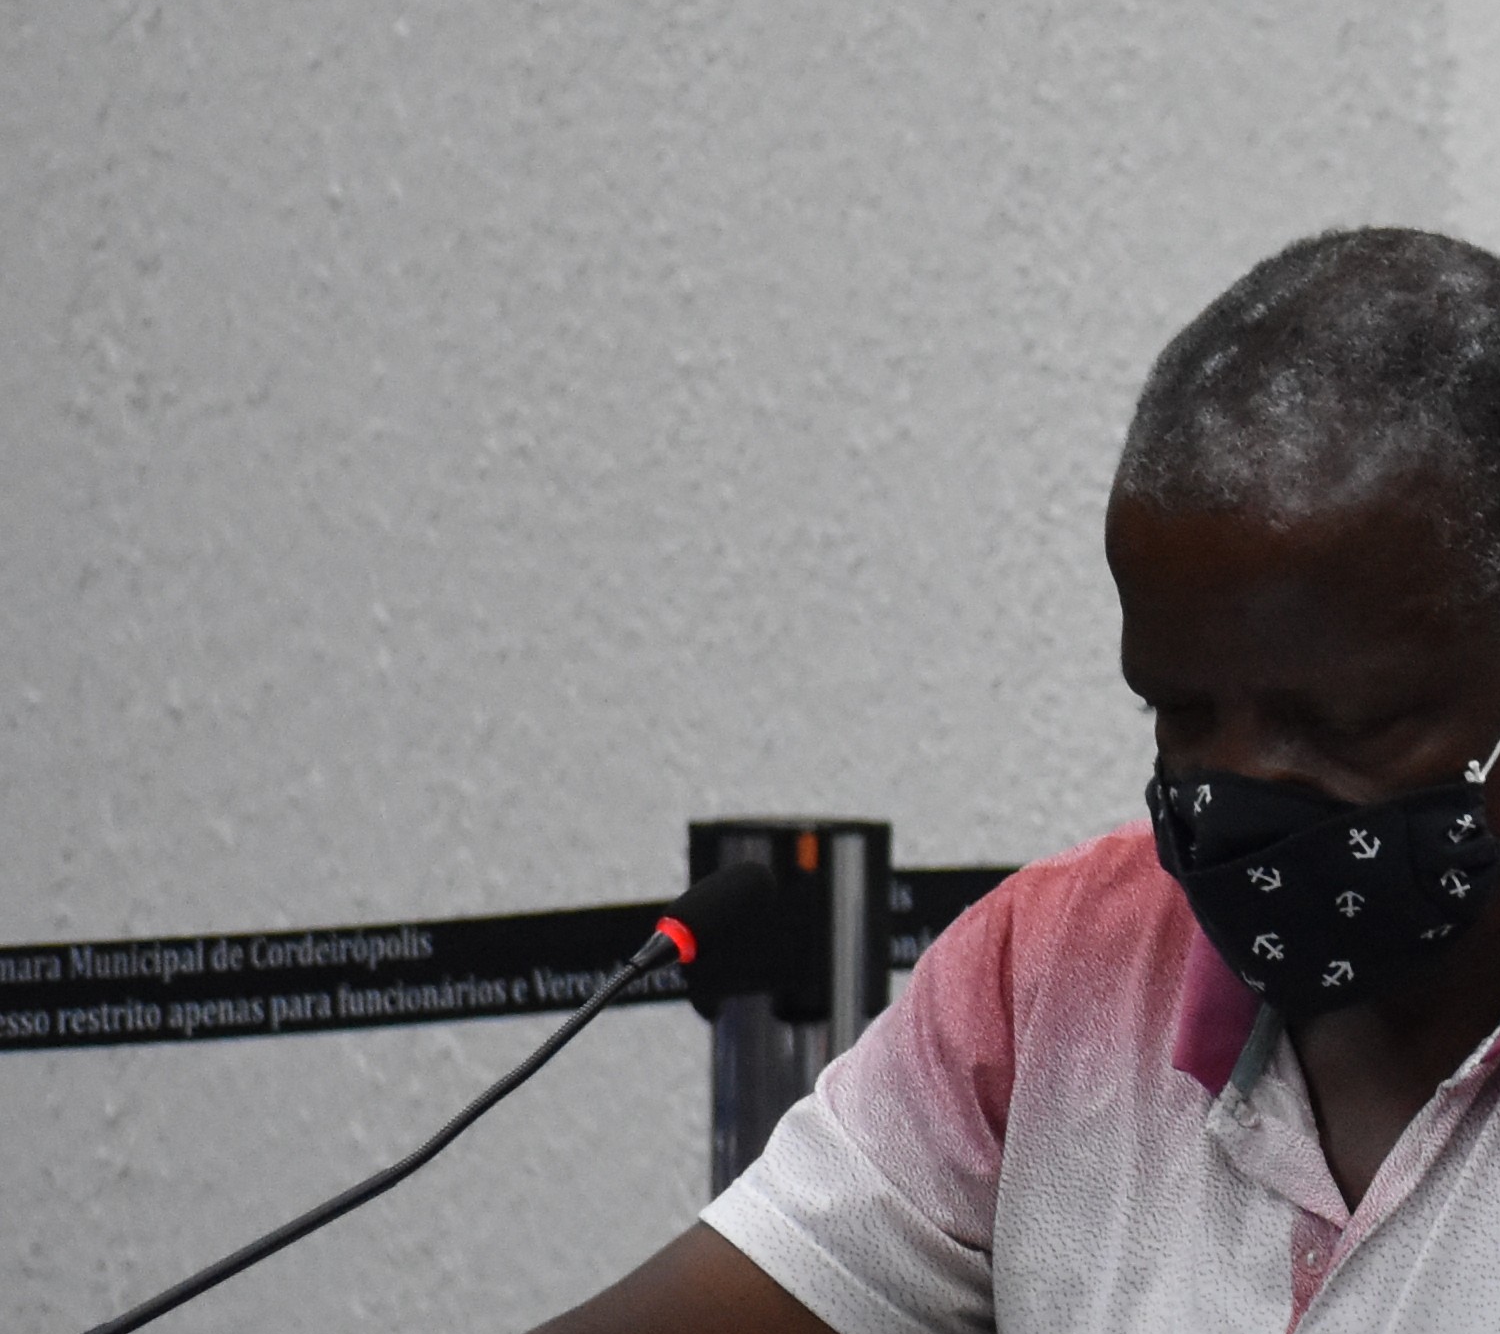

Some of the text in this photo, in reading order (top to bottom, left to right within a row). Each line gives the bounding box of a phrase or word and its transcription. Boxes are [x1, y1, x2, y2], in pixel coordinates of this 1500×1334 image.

[69, 940, 204, 984] Municipal
[211, 938, 244, 972] de
[251, 924, 433, 971] Cordeirópolis
[56, 999, 162, 1035] restrito
[168, 996, 265, 1037] apenas
[269, 993, 331, 1031] para
[337, 973, 506, 1017] funcionários
[511, 976, 528, 1005] e
